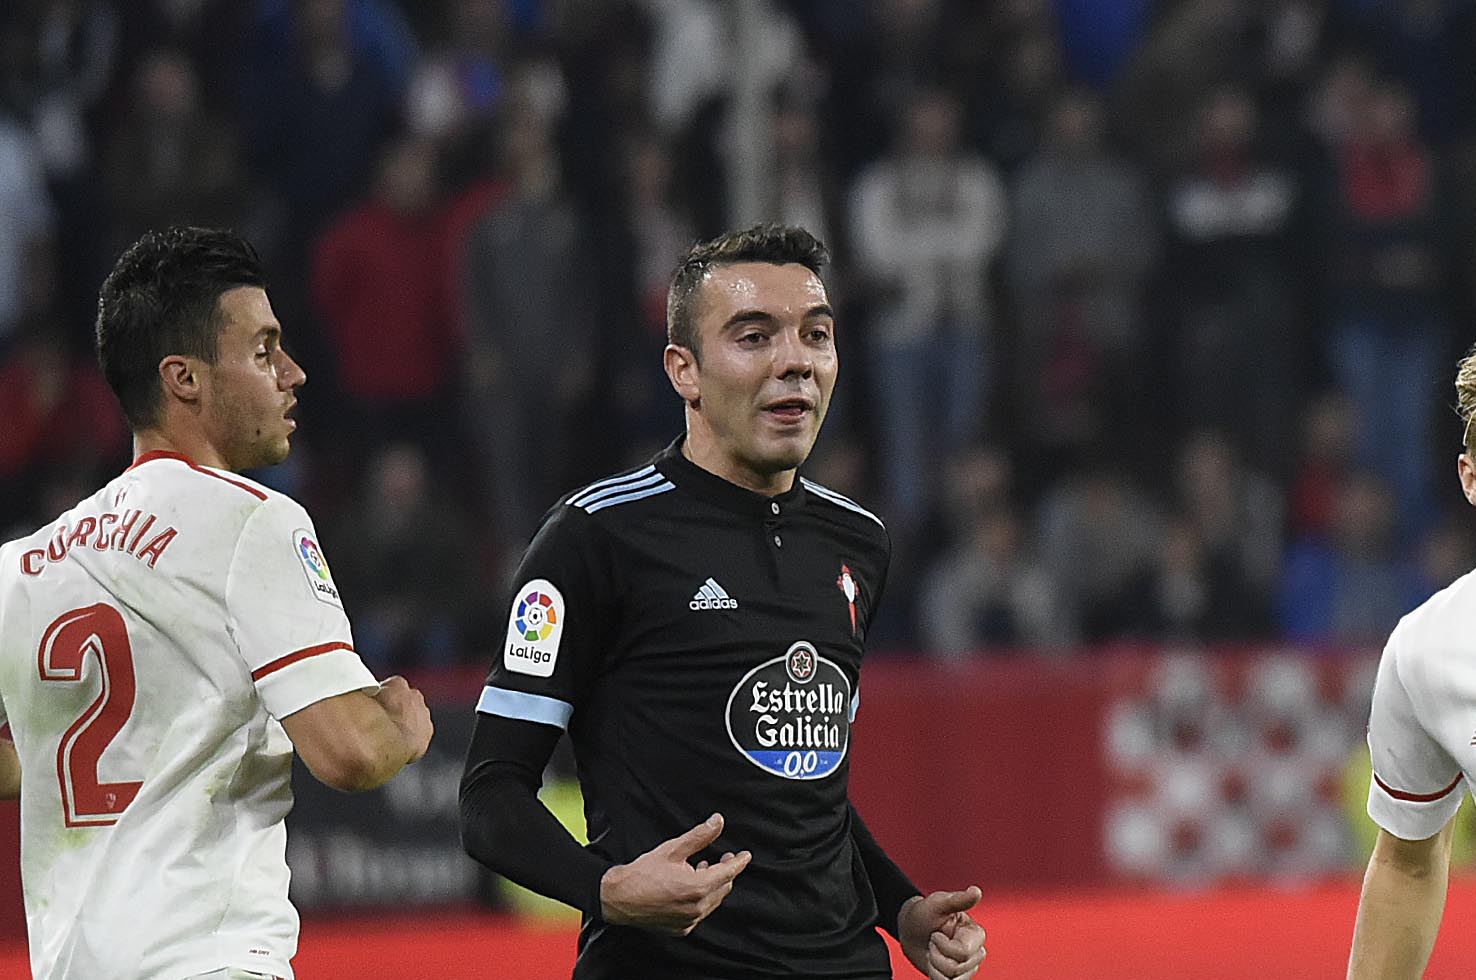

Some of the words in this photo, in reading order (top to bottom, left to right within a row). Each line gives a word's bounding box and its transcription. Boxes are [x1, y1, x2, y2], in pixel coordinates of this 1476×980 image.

[689, 597, 738, 611] adidas
[509, 643, 551, 664] LaLiga
[749, 681, 844, 714] Estrella
[38, 602, 144, 829] 2
[755, 714, 840, 748] Galicia
